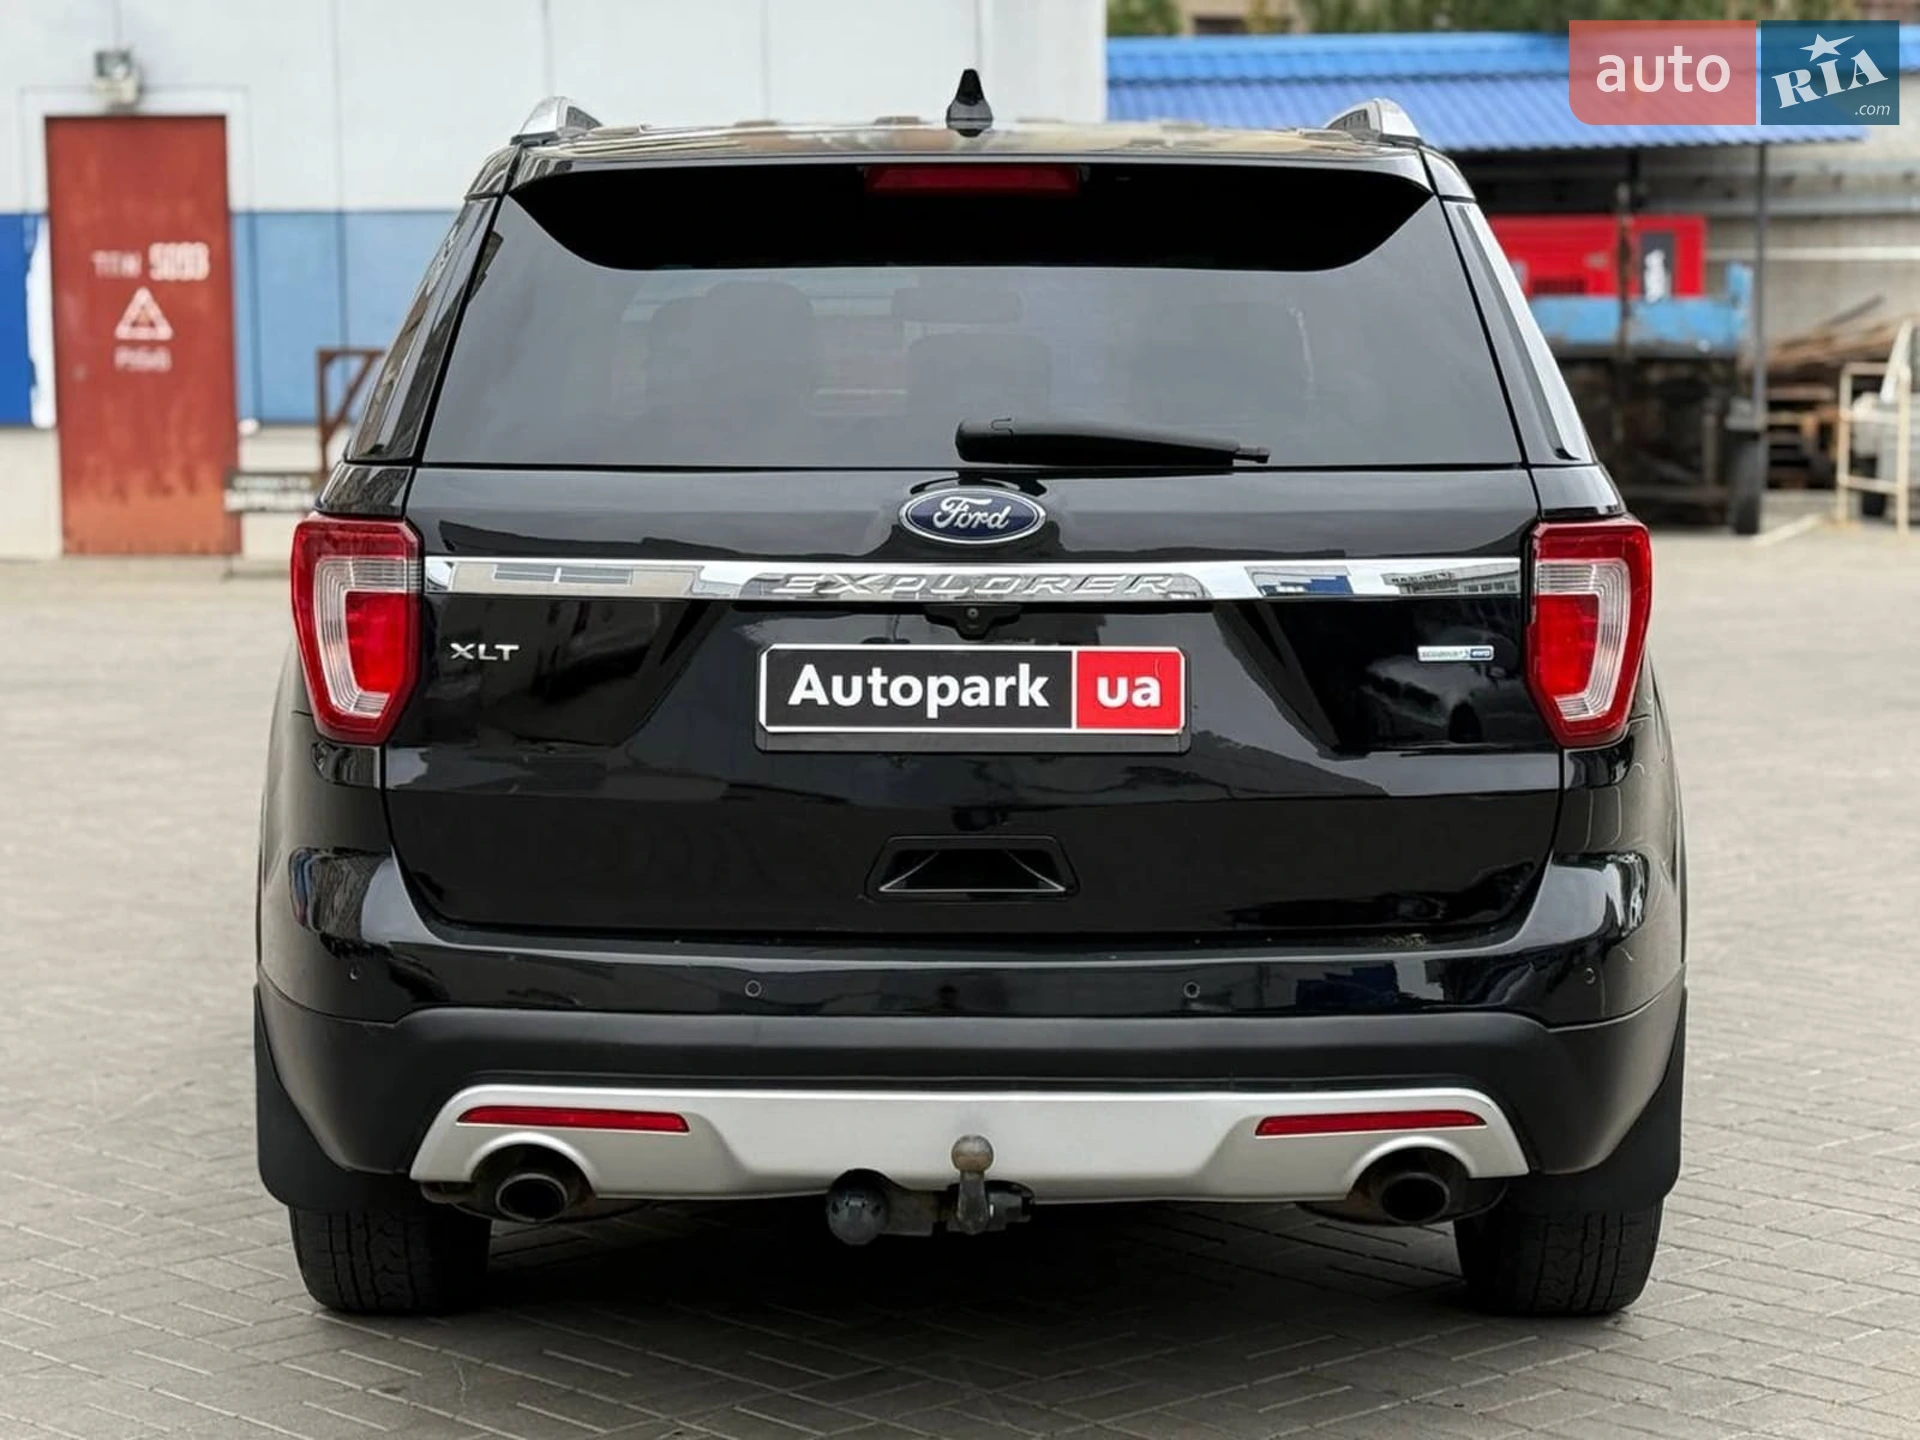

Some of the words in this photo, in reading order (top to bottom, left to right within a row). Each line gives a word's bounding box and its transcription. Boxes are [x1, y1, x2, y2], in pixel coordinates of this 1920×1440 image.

[933, 496, 1013, 531] Ford
[773, 573, 1175, 596] EXPLORER
[449, 642, 520, 661] XLT
[787, 662, 1051, 720] Autopark
[1096, 675, 1162, 708] ua
